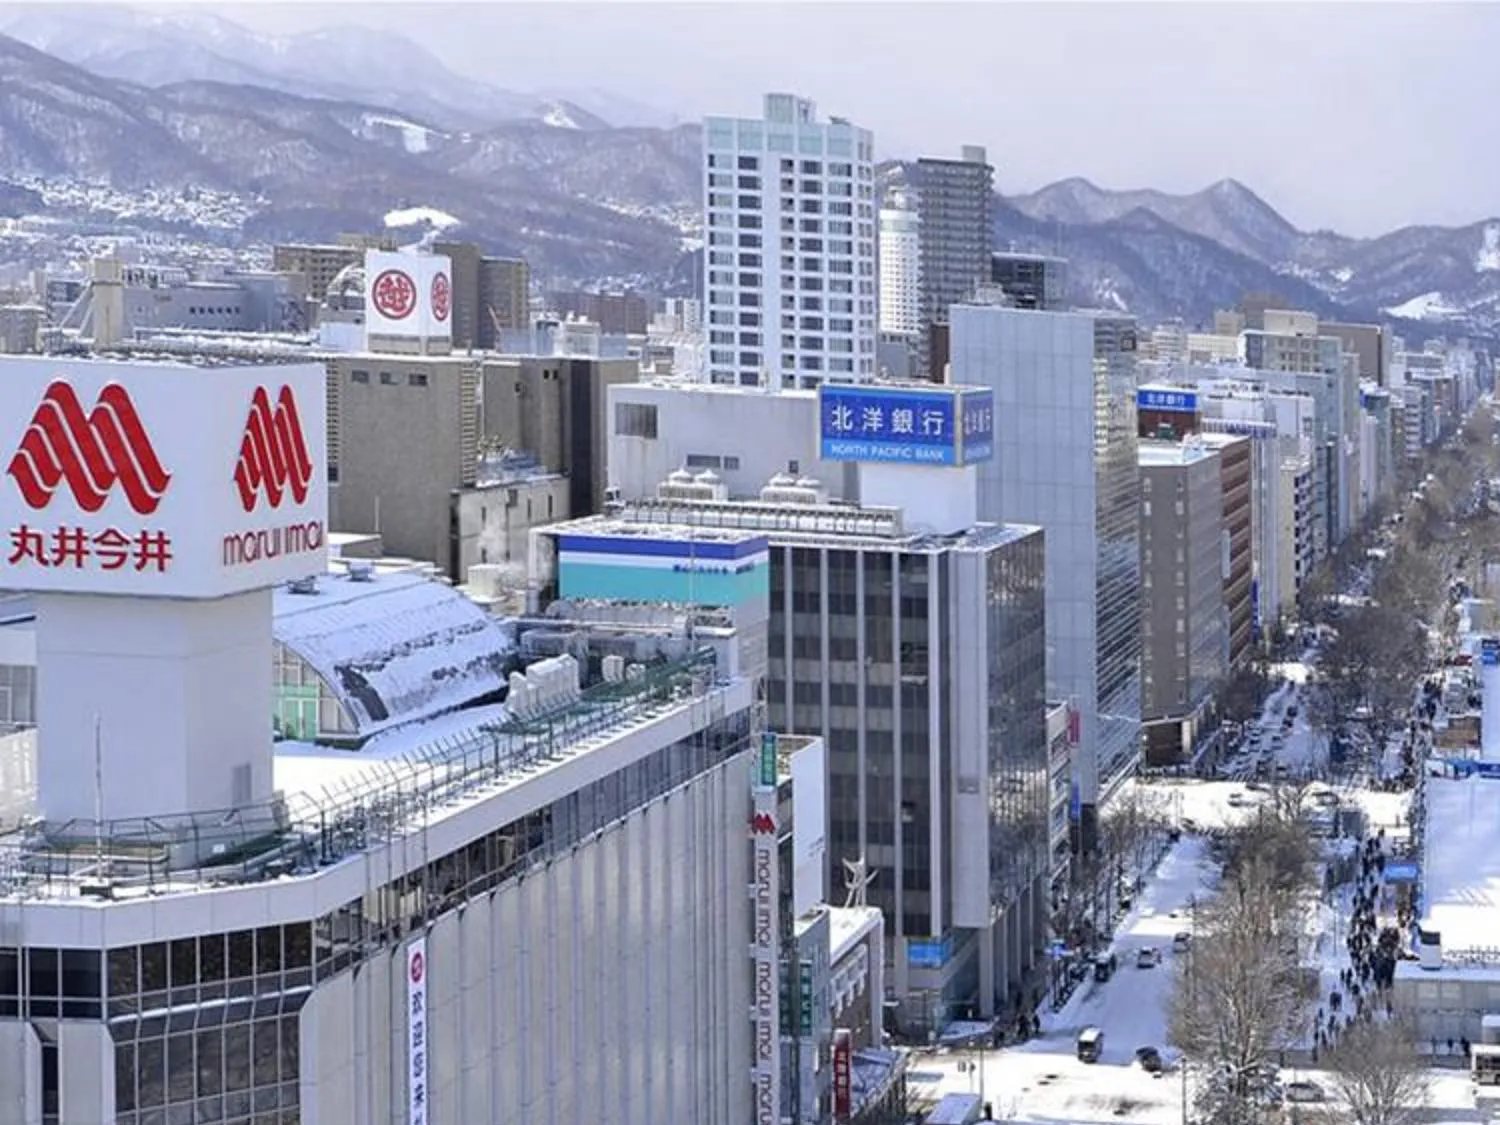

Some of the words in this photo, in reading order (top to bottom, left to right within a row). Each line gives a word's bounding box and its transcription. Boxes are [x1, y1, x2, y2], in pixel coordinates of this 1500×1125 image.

[832, 405, 944, 436] 北洋銀行
[831, 445, 867, 455] NORTH
[871, 445, 912, 459] PACIFIC
[915, 449, 945, 460] BANK
[8, 524, 173, 573] 丸井今井
